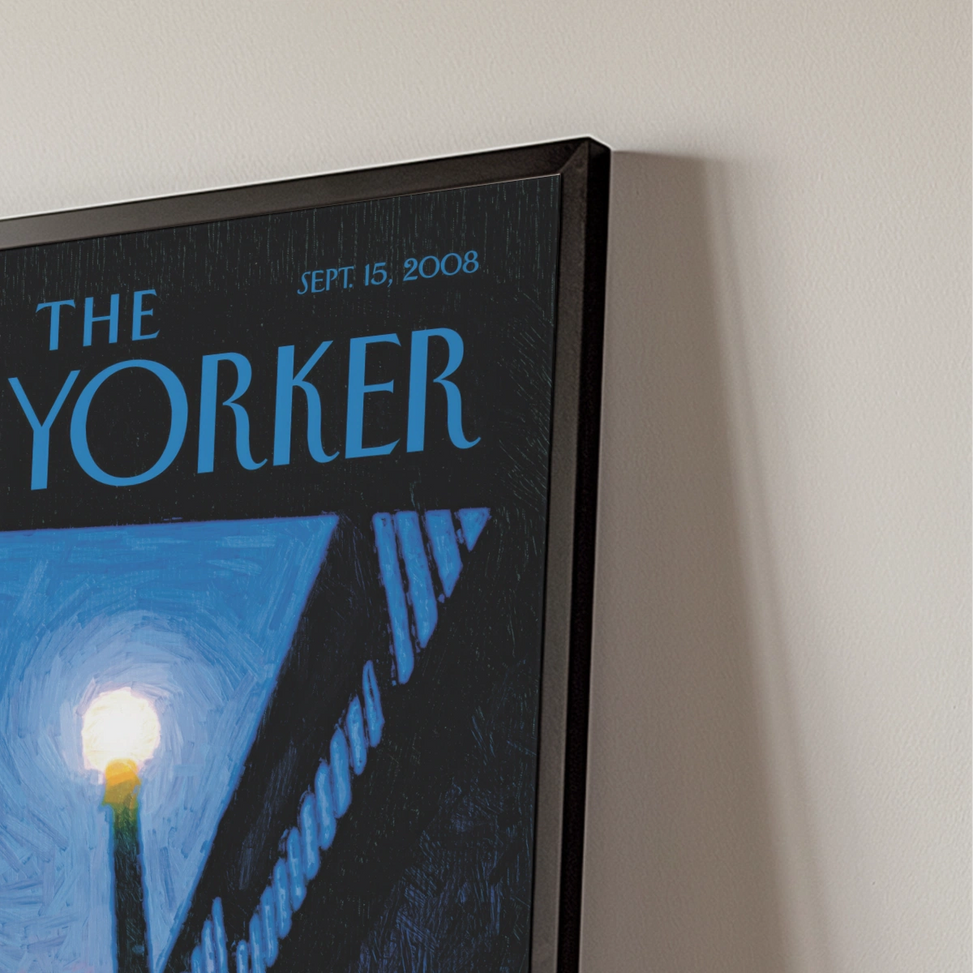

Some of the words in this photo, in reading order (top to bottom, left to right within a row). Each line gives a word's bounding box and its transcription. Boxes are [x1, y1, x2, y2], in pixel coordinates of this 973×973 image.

[296, 265, 354, 295] SEPT.
[364, 261, 393, 288] 15,
[402, 249, 480, 282] 2008
[35, 288, 160, 351] THE
[7, 327, 482, 491] YORKER
